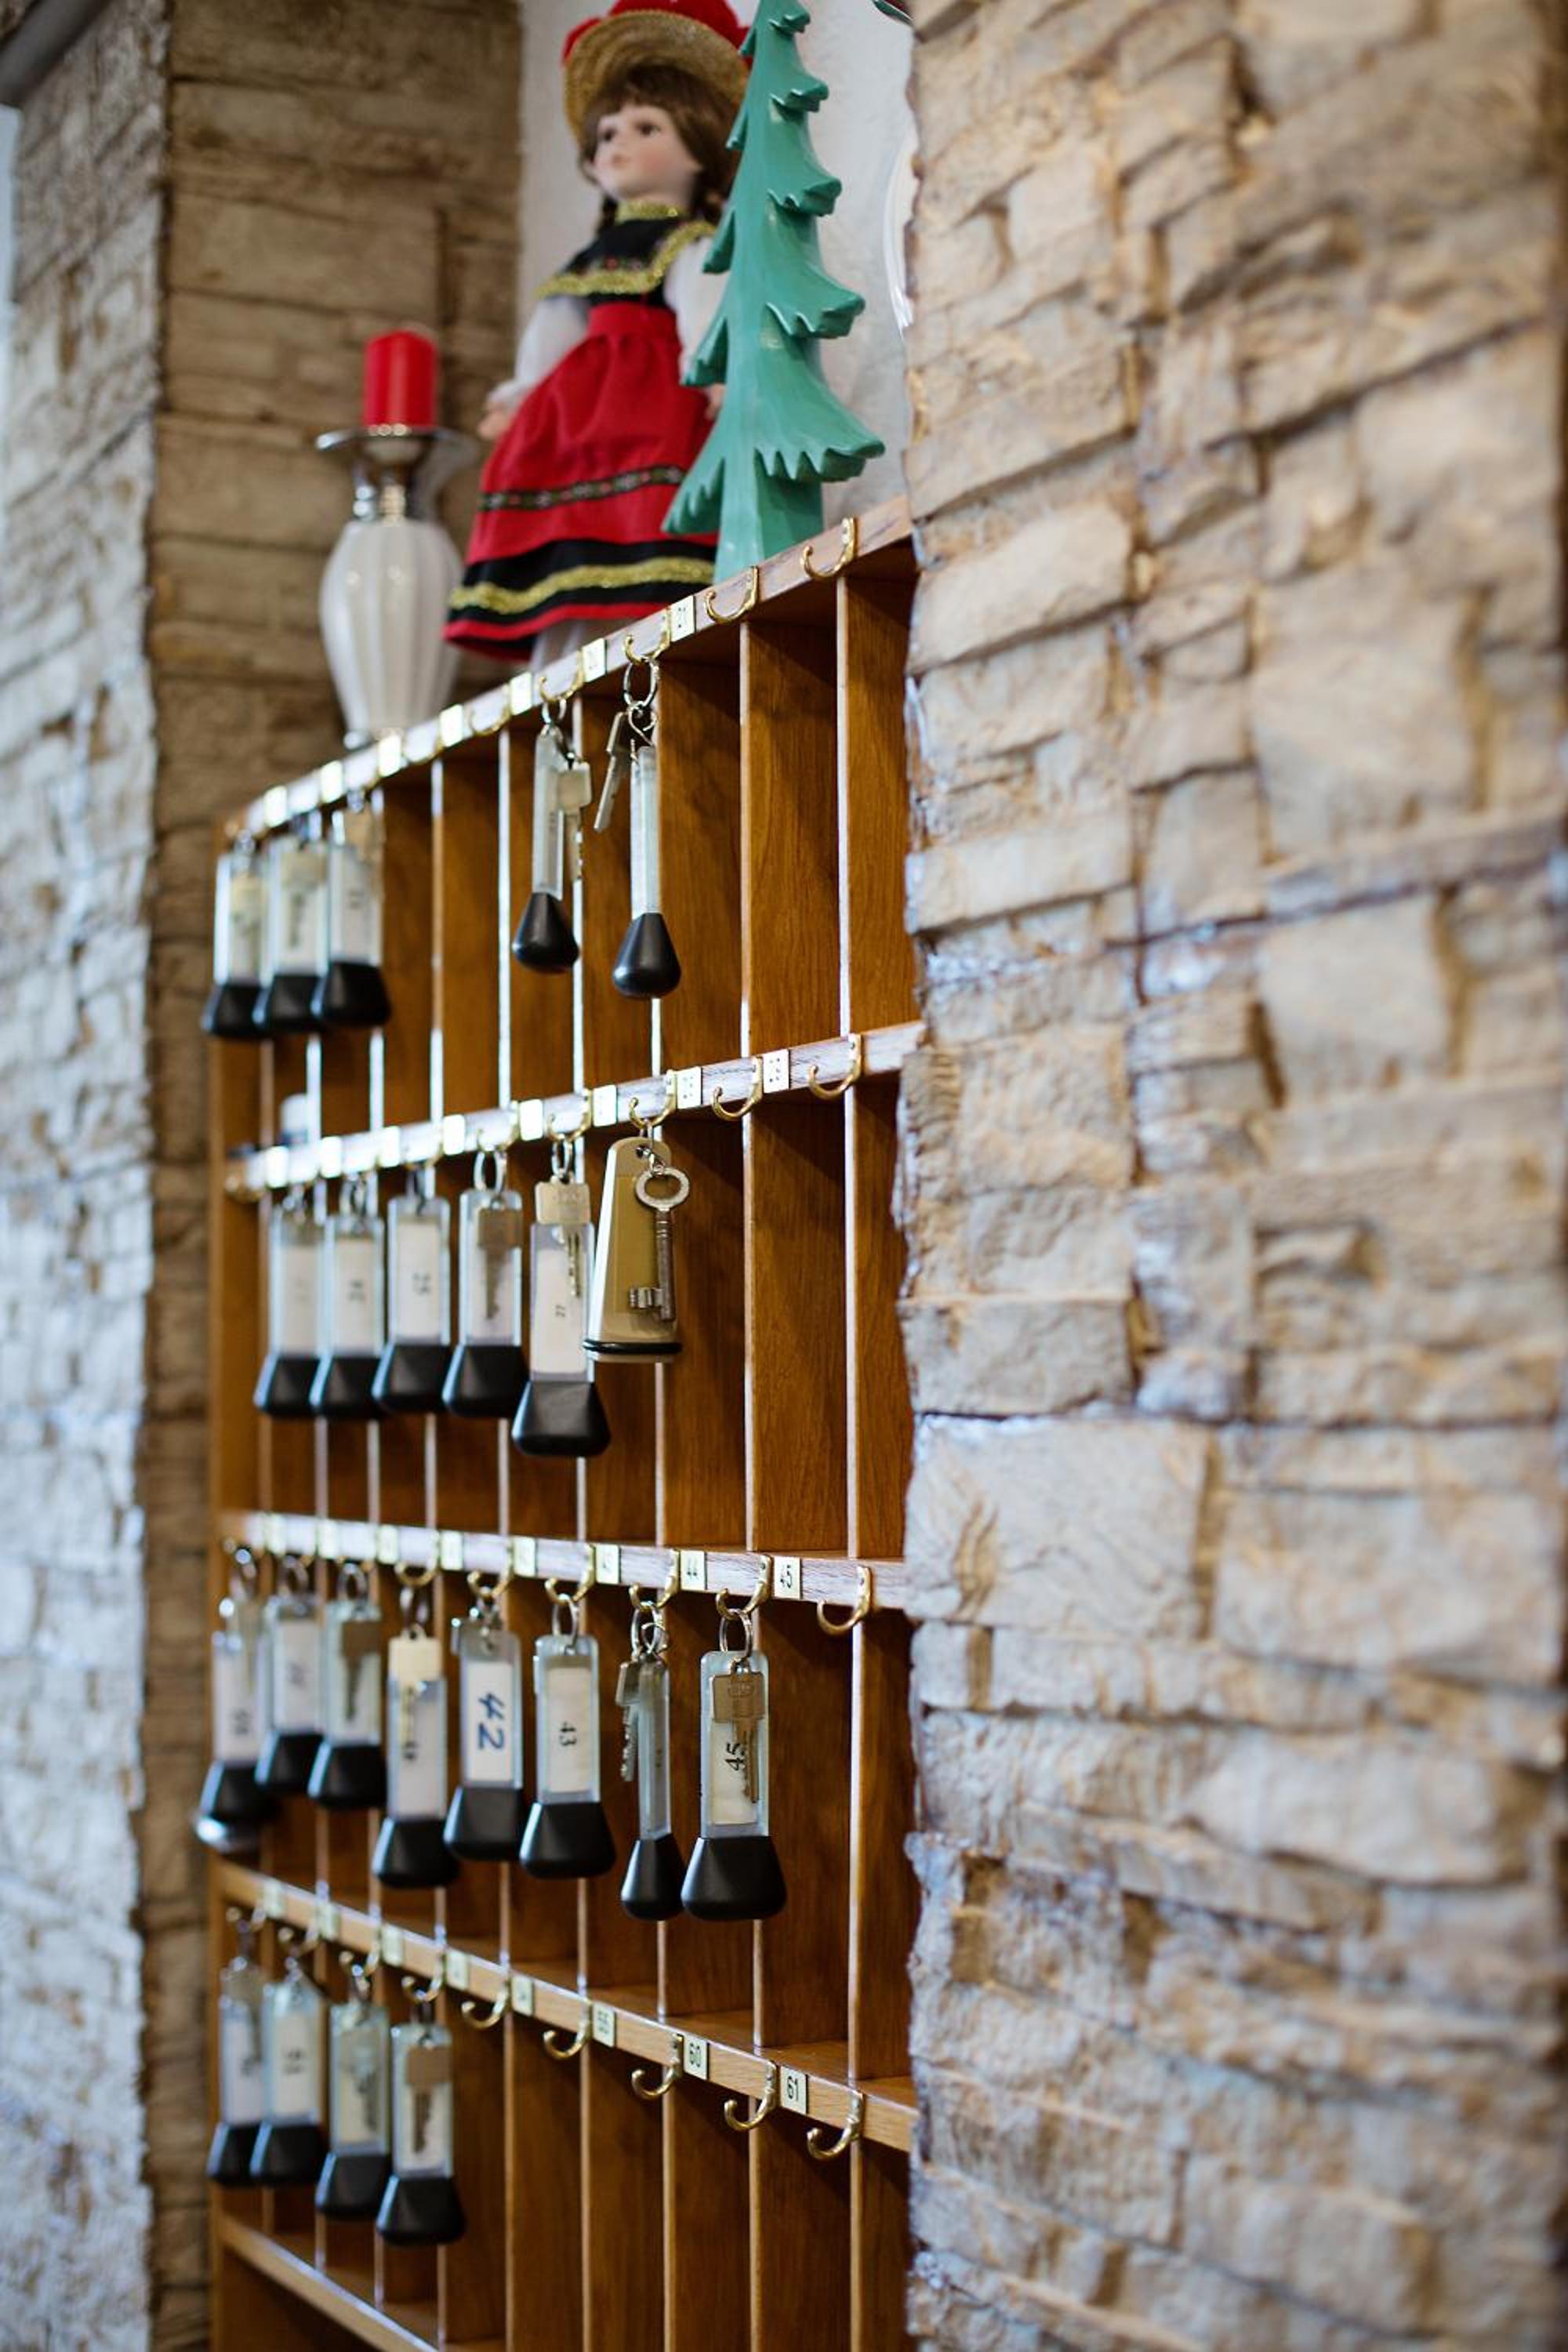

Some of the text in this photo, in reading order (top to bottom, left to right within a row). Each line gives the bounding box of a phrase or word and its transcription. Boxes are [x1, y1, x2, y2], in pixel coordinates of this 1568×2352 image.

[477, 1692, 505, 1751] 42
[558, 1720, 578, 1747] 43
[725, 1741, 745, 1771] 45
[787, 2075, 799, 2102] 61
